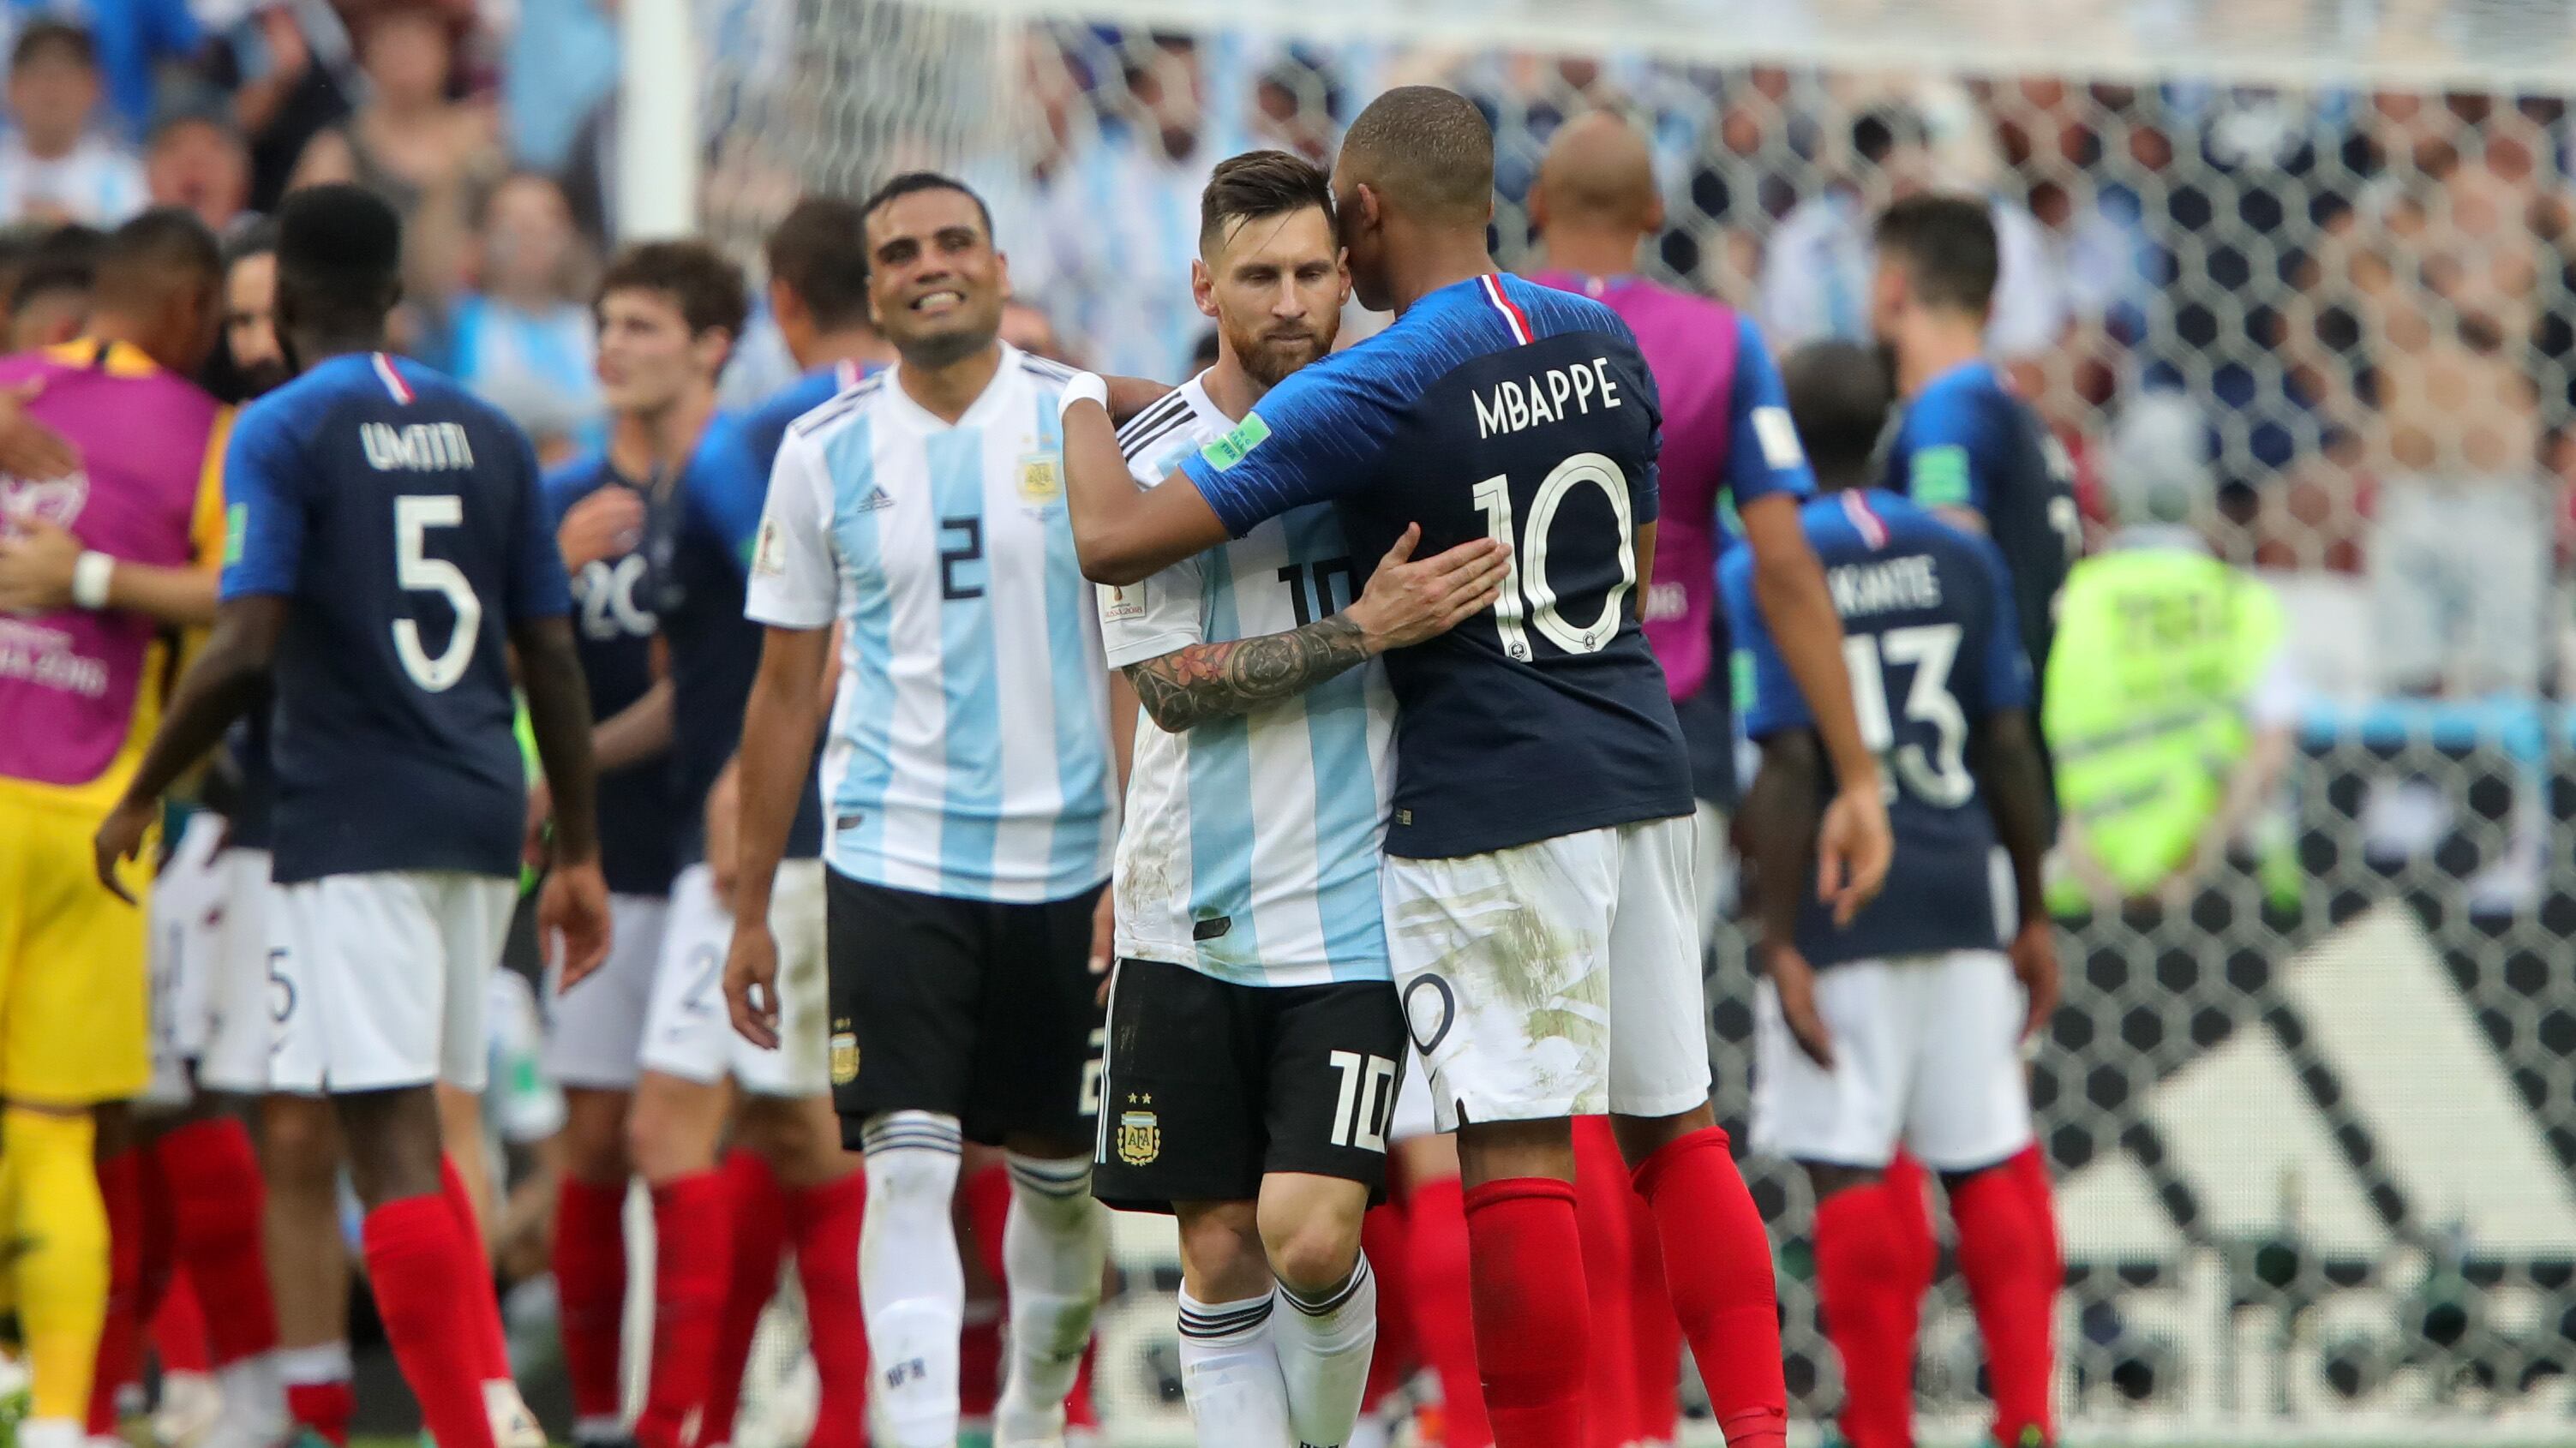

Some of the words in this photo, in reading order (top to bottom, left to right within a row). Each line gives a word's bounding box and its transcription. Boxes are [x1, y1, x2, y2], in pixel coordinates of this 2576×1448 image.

[1471, 356, 1621, 440] MBAPPE
[392, 494, 483, 692] 5
[941, 518, 984, 600] 2
[1472, 452, 1636, 663] 10
[1842, 623, 1975, 809] 13
[268, 946, 297, 1023] 5
[1329, 1050, 1397, 1154] 10
